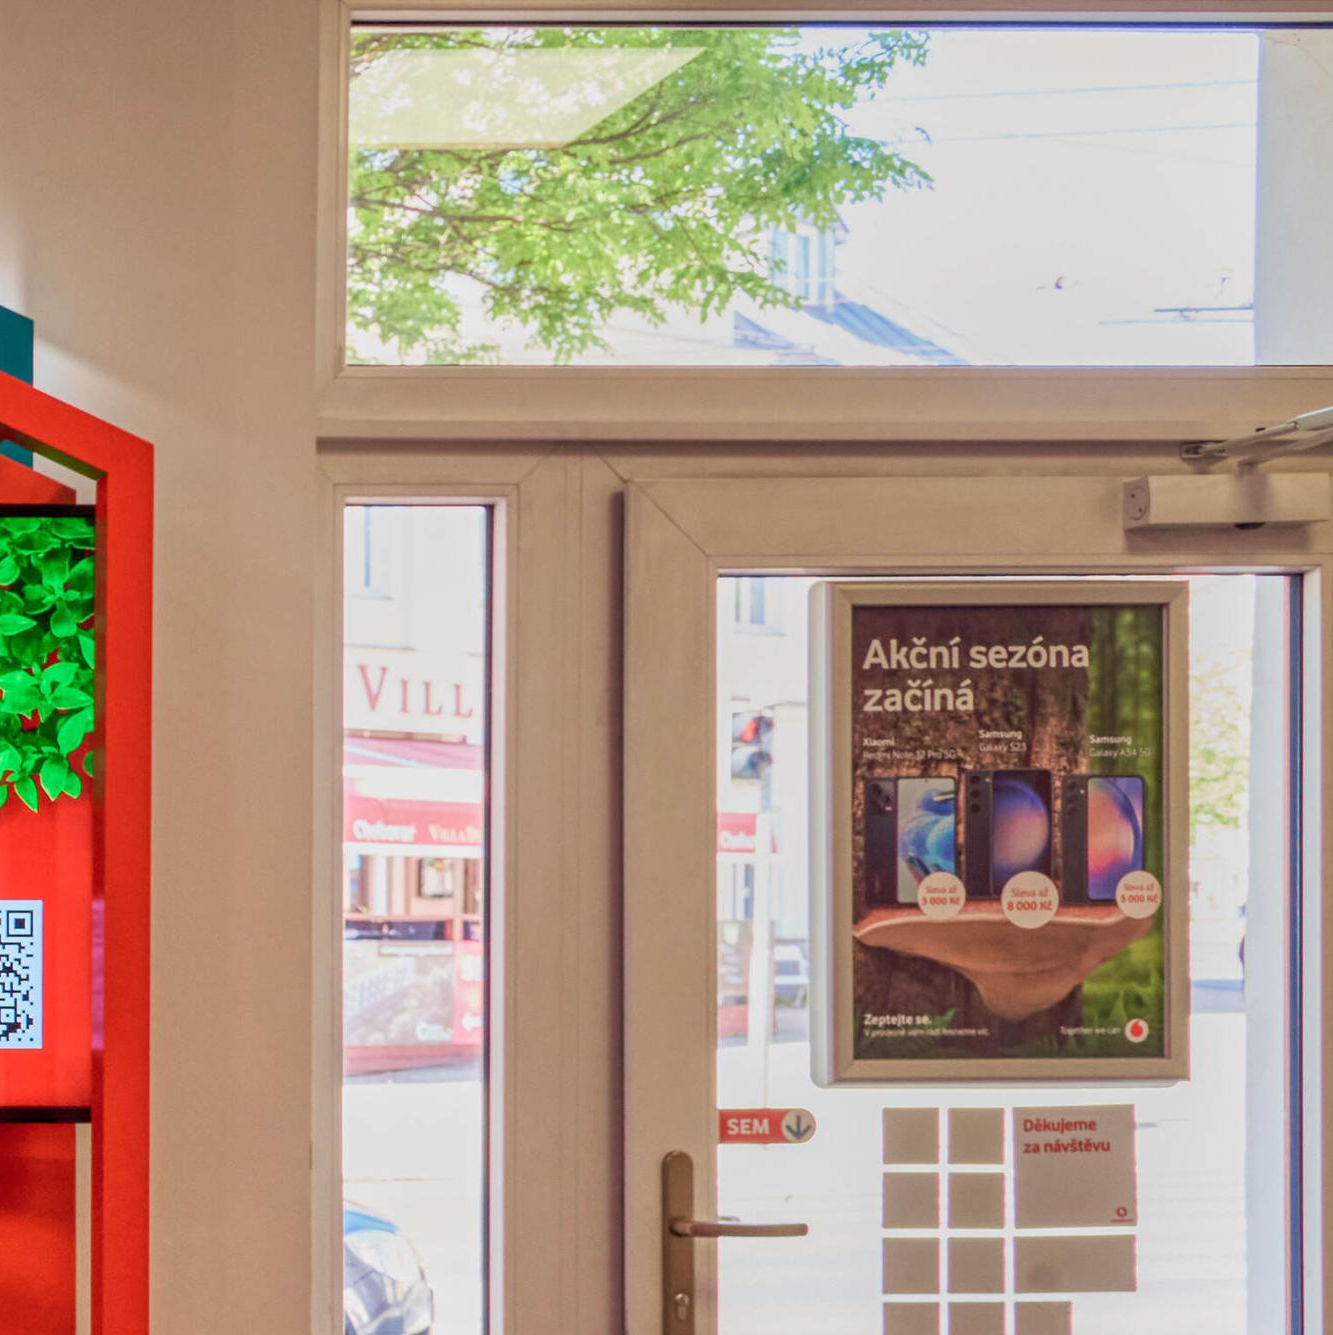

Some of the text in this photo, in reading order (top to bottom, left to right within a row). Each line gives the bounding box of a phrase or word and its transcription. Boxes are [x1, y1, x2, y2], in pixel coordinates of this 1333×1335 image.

[862, 636, 1090, 670] Akční sezóna
[863, 678, 975, 712] začíná
[978, 729, 1022, 740] Samsung
[1089, 735, 1132, 745] Samsung
[1016, 901, 1037, 911] 000
[863, 1013, 913, 1027] Zeptejte
[726, 1118, 770, 1135] SEM
[1023, 1118, 1097, 1135] Děkujeme
[1023, 1138, 1111, 1154] za návštěvu
